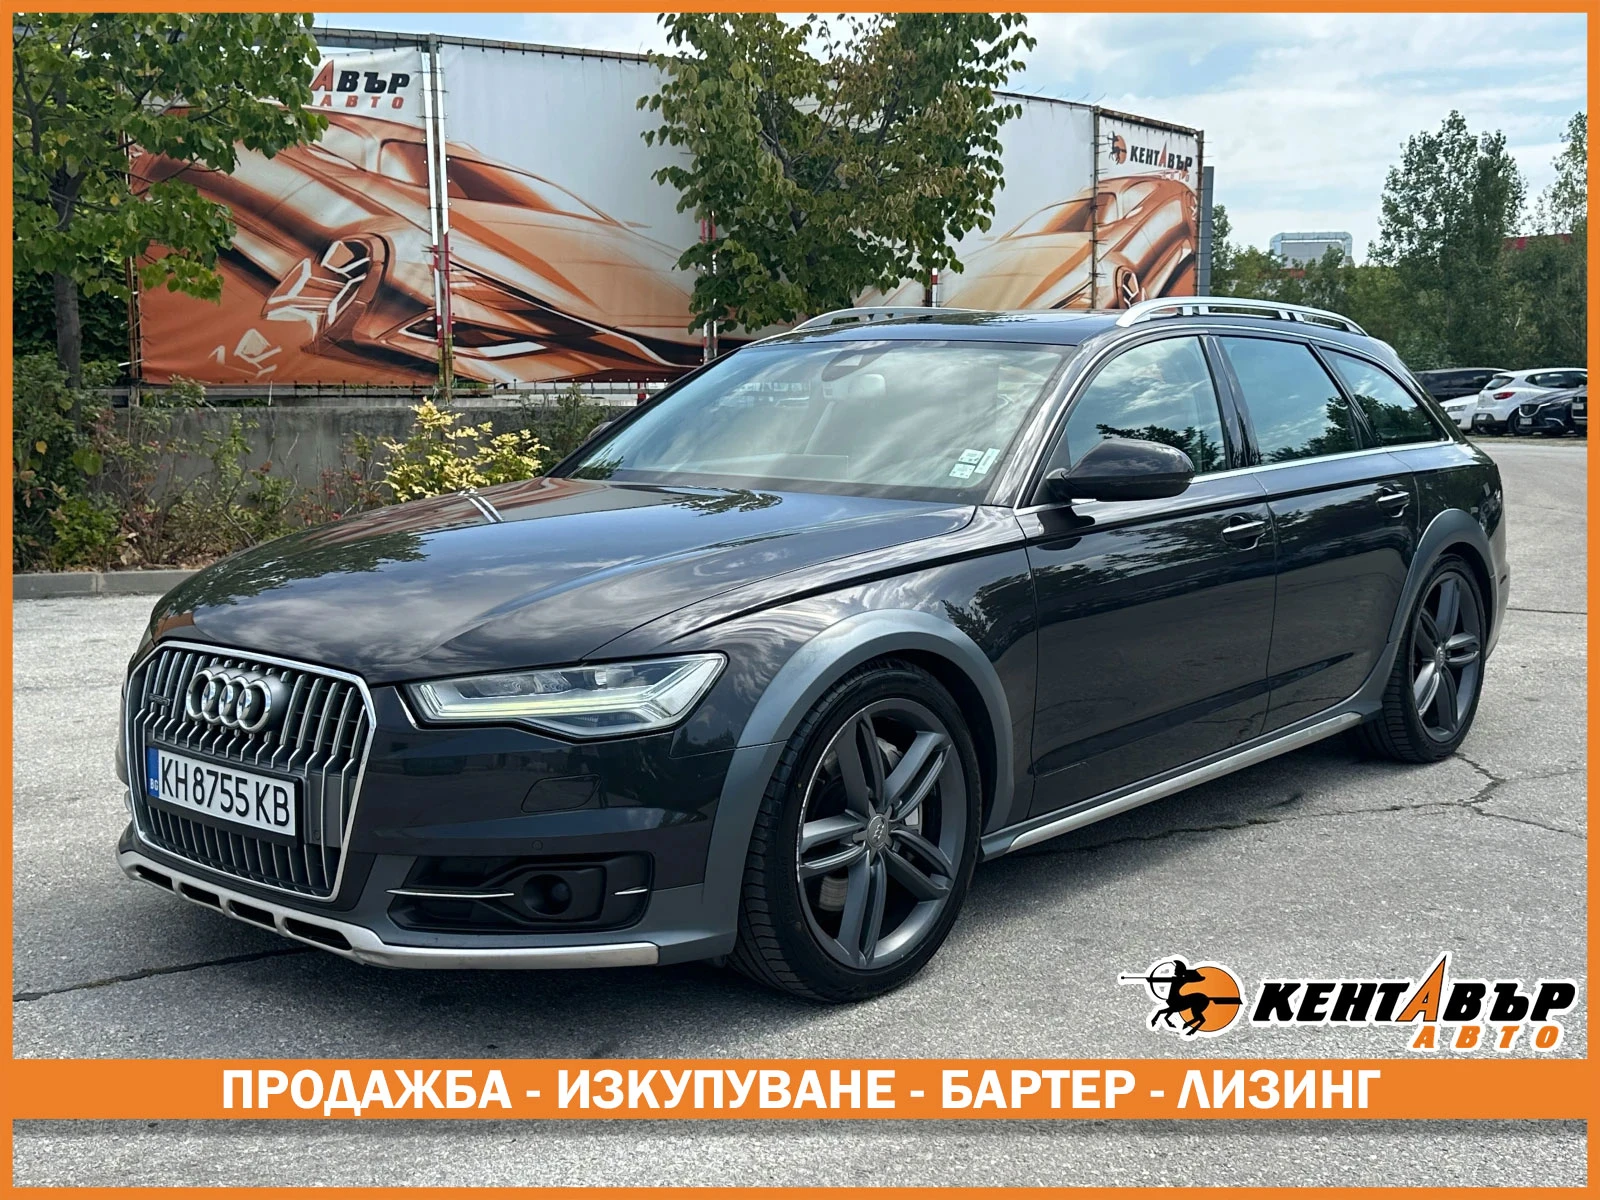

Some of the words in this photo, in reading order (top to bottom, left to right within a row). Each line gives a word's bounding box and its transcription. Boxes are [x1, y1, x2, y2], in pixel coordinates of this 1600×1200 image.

[309, 59, 411, 95] АВЪР
[320, 94, 405, 110] АВТО
[1129, 140, 1193, 171] КЕНТАВЪР
[150, 778, 159, 791] BG
[192, 766, 250, 818] 8755
